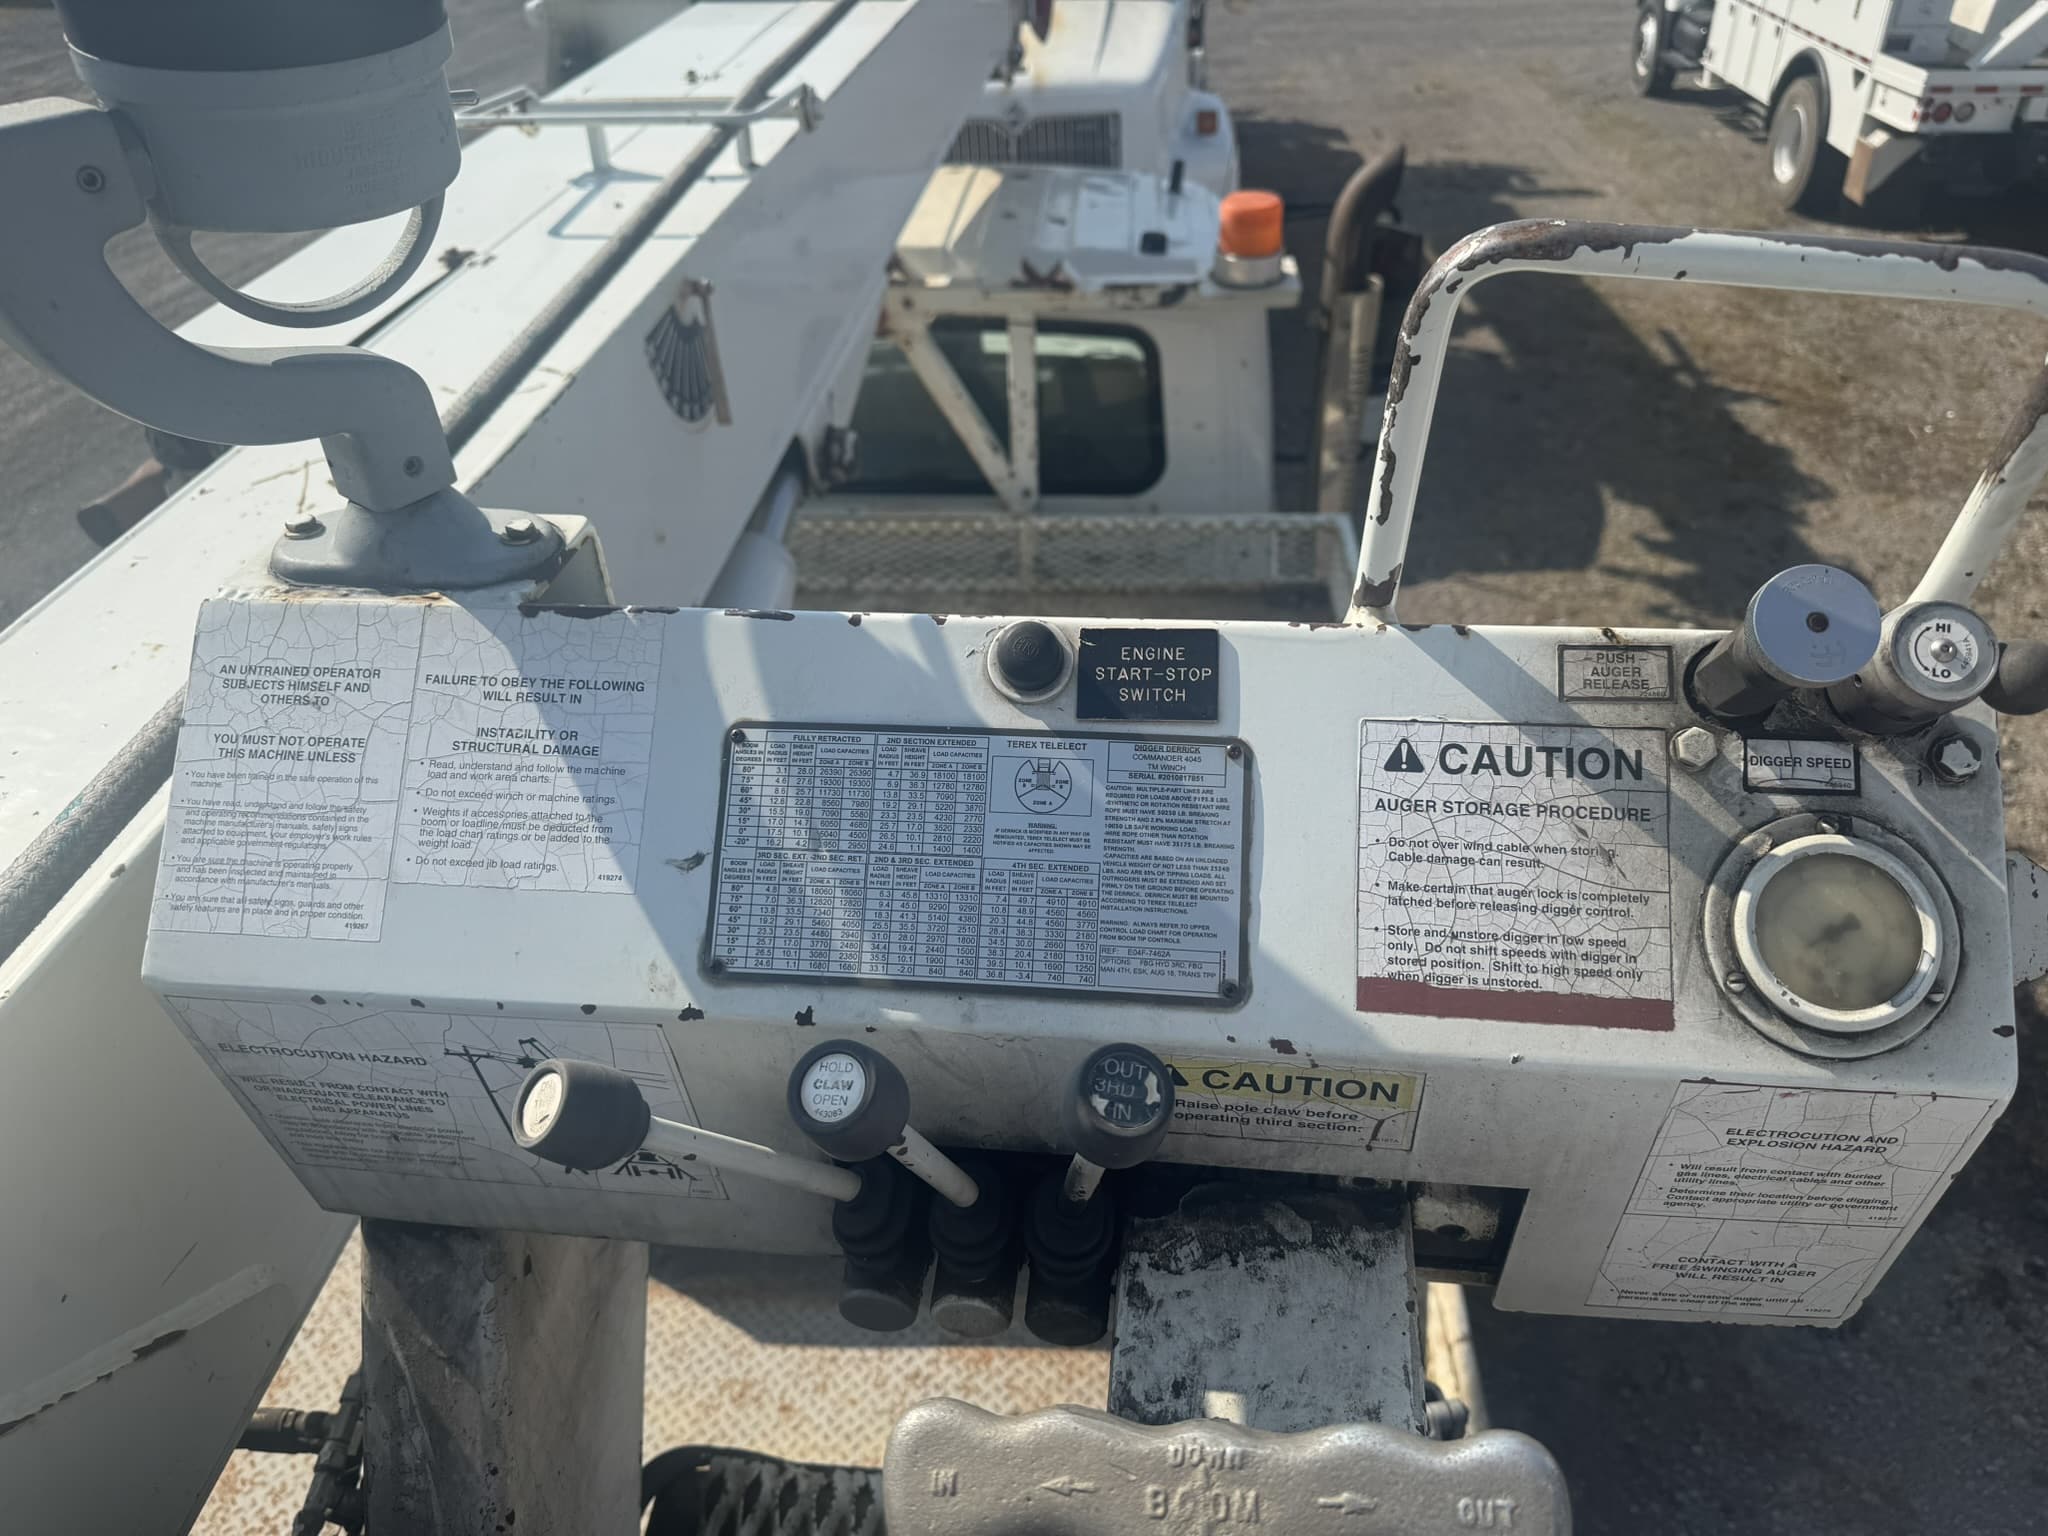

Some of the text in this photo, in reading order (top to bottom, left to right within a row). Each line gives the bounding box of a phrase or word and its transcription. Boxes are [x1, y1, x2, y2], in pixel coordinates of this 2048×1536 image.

[1935, 623, 1951, 633] HI
[1121, 647, 1185, 661] ENGINE
[1597, 653, 1635, 663] PUSH
[219, 665, 380, 679] AN UNTRAINED OPERATOR
[1095, 667, 1212, 681] START-STOP
[1591, 666, 1641, 677] AUGER
[1932, 668, 1951, 679] LO
[222, 679, 370, 692] SUBJECTS HIMSELF AND
[425, 675, 645, 692] FAILURE TO OBEY THE FOLLOWING
[1583, 679, 1649, 689] RELEASE
[261, 695, 329, 706] OTHERS TO
[483, 691, 582, 704] WILL RESULT IN
[1119, 689, 1186, 702] SWITCH
[214, 734, 366, 748] YOU MUST NOT OPERATE
[559, 730, 578, 740] OR
[452, 742, 599, 756] STRUCTURAL DAMAGE
[1008, 741, 1087, 751] TEREX TELELECT
[1134, 744, 1200, 753] DIGGER DERRICK
[219, 749, 356, 763] THIS MACHINE UNLESS
[1132, 754, 1182, 762] COMMANDER
[1439, 744, 1642, 780] CAUTION
[1750, 756, 1852, 769] DIGGER SPEED
[1148, 763, 1158, 771] TM
[1128, 772, 1156, 780] SERIAL
[1375, 798, 1650, 821] AUGER STORAGE PROCEDURE
[1389, 837, 1619, 860] Do not over wind cable when storig.
[416, 856, 559, 872] Do not exceed jib load ratings.
[1389, 852, 1422, 862] Cable
[1426, 854, 1475, 866] damage
[1480, 857, 1500, 866] can
[1388, 880, 1650, 905] Make certain that auger lock is completely
[1388, 896, 1634, 918] latched before releasing digger control.
[1388, 925, 1626, 948] Store and unstore digger in low speed
[1425, 942, 1442, 952] Do
[1446, 944, 1466, 954] not
[1470, 945, 1498, 956] shift
[1502, 947, 1546, 960] speeds
[1550, 949, 1576, 960] with
[1581, 951, 1622, 964] digger
[1626, 952, 1636, 963] in
[1388, 956, 1643, 981] stored position. Shift to high speed only
[1388, 972, 1542, 988] when digger is unstored.
[218, 1043, 427, 1066] ELECTROCUTION HAZARD
[820, 1062, 853, 1072] HOLD
[1105, 1058, 1148, 1080] OUT
[814, 1079, 854, 1090] CLAW
[1202, 1070, 1399, 1102] CAUTION
[813, 1094, 848, 1105] OPEN
[1113, 1104, 1131, 1120] IN
[1175, 1099, 1358, 1121] Raise pole claw before
[1174, 1111, 1250, 1125] operating
[1256, 1115, 1292, 1127] third
[1725, 1128, 1899, 1144] ELECTROCUTION AND
[1726, 1138, 1888, 1154] EXPLOSION HAZARD
[1741, 1167, 1768, 1175] from
[1770, 1169, 1814, 1177] contact
[1678, 1257, 1749, 1266] CONTACT
[1750, 1260, 1785, 1268] WITH
[1692, 1266, 1763, 1275] SWINGING
[1712, 1275, 1767, 1283] RESULT
[930, 1470, 958, 1496] IN
[1457, 1498, 1516, 1529] OUT
